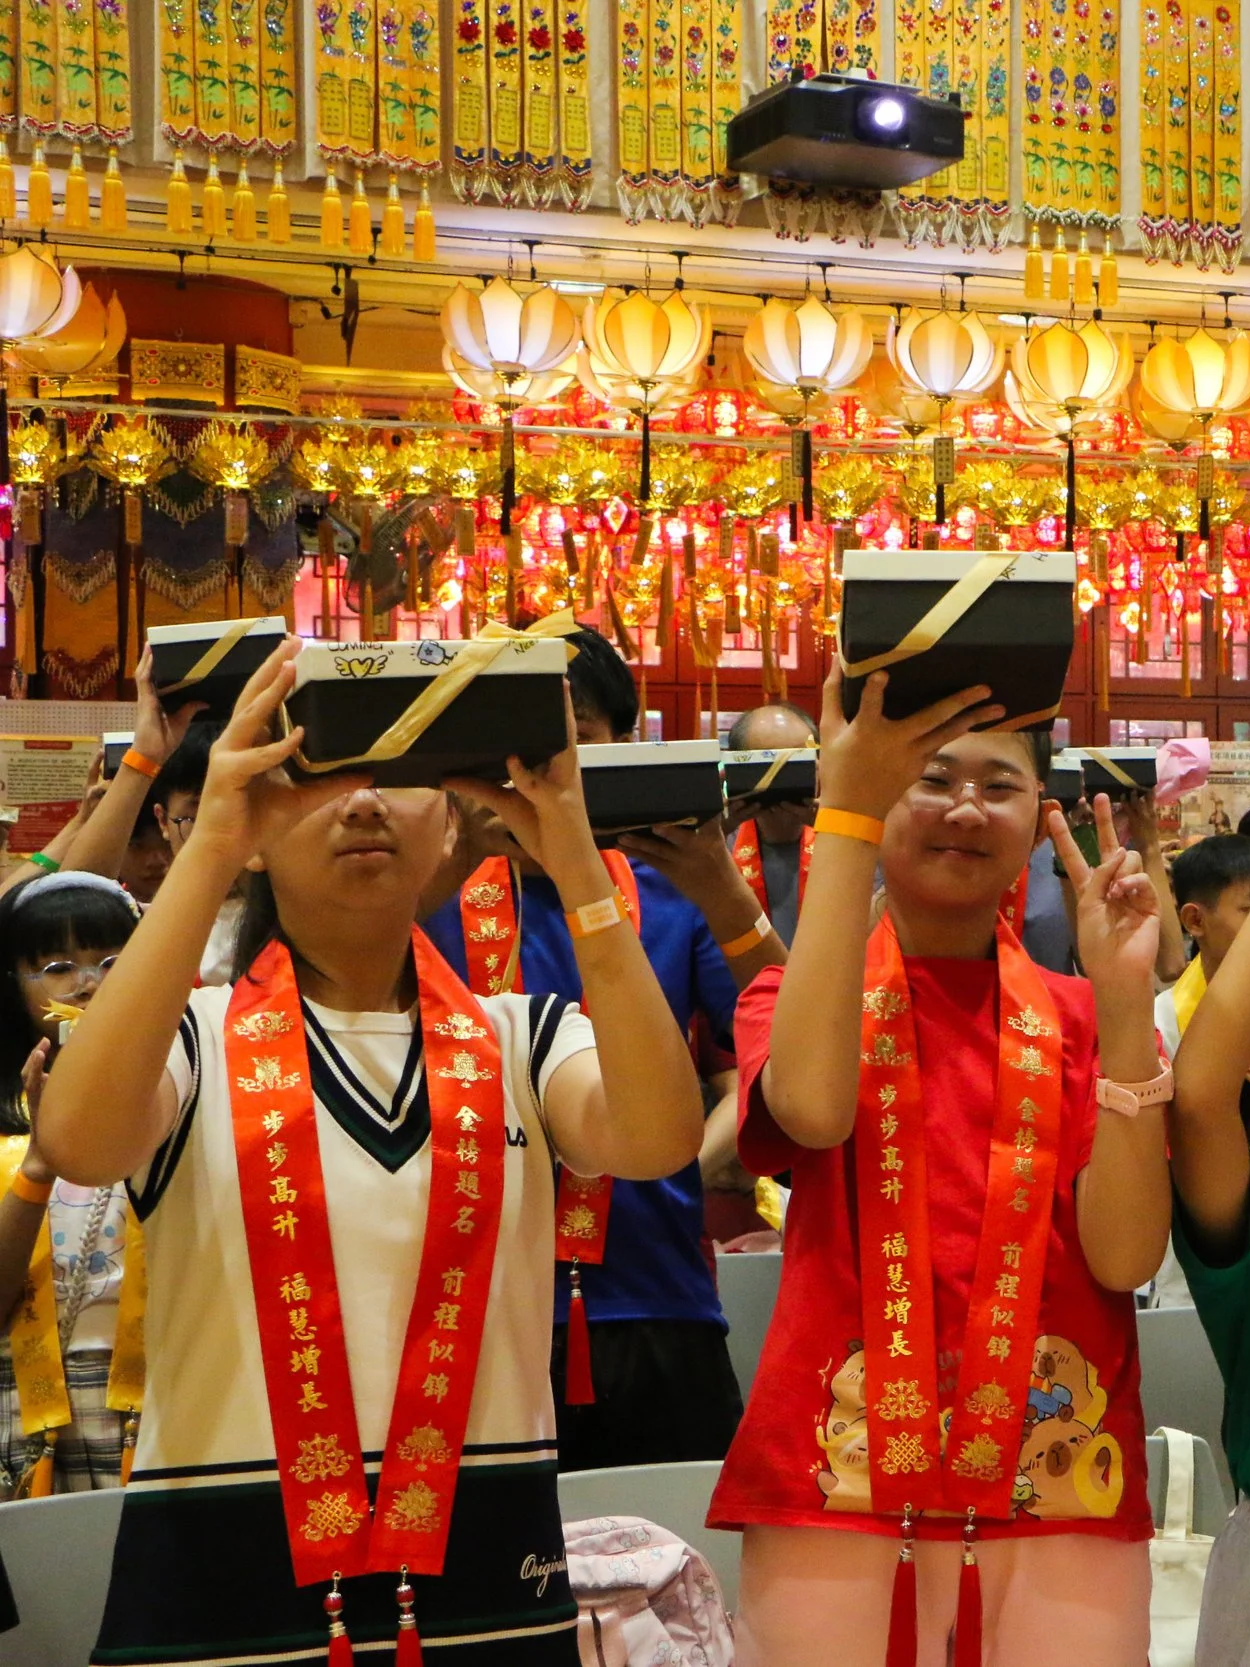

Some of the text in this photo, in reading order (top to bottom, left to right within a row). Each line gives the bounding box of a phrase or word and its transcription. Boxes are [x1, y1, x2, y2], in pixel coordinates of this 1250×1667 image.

[261, 1109, 328, 1413] 步步高升 福慧增長
[421, 1105, 484, 1403] 金榜題名 前程似錦
[877, 1083, 913, 1358] 步步高升 福慧增長
[986, 1096, 1042, 1363] 金榜題名 前程似錦
